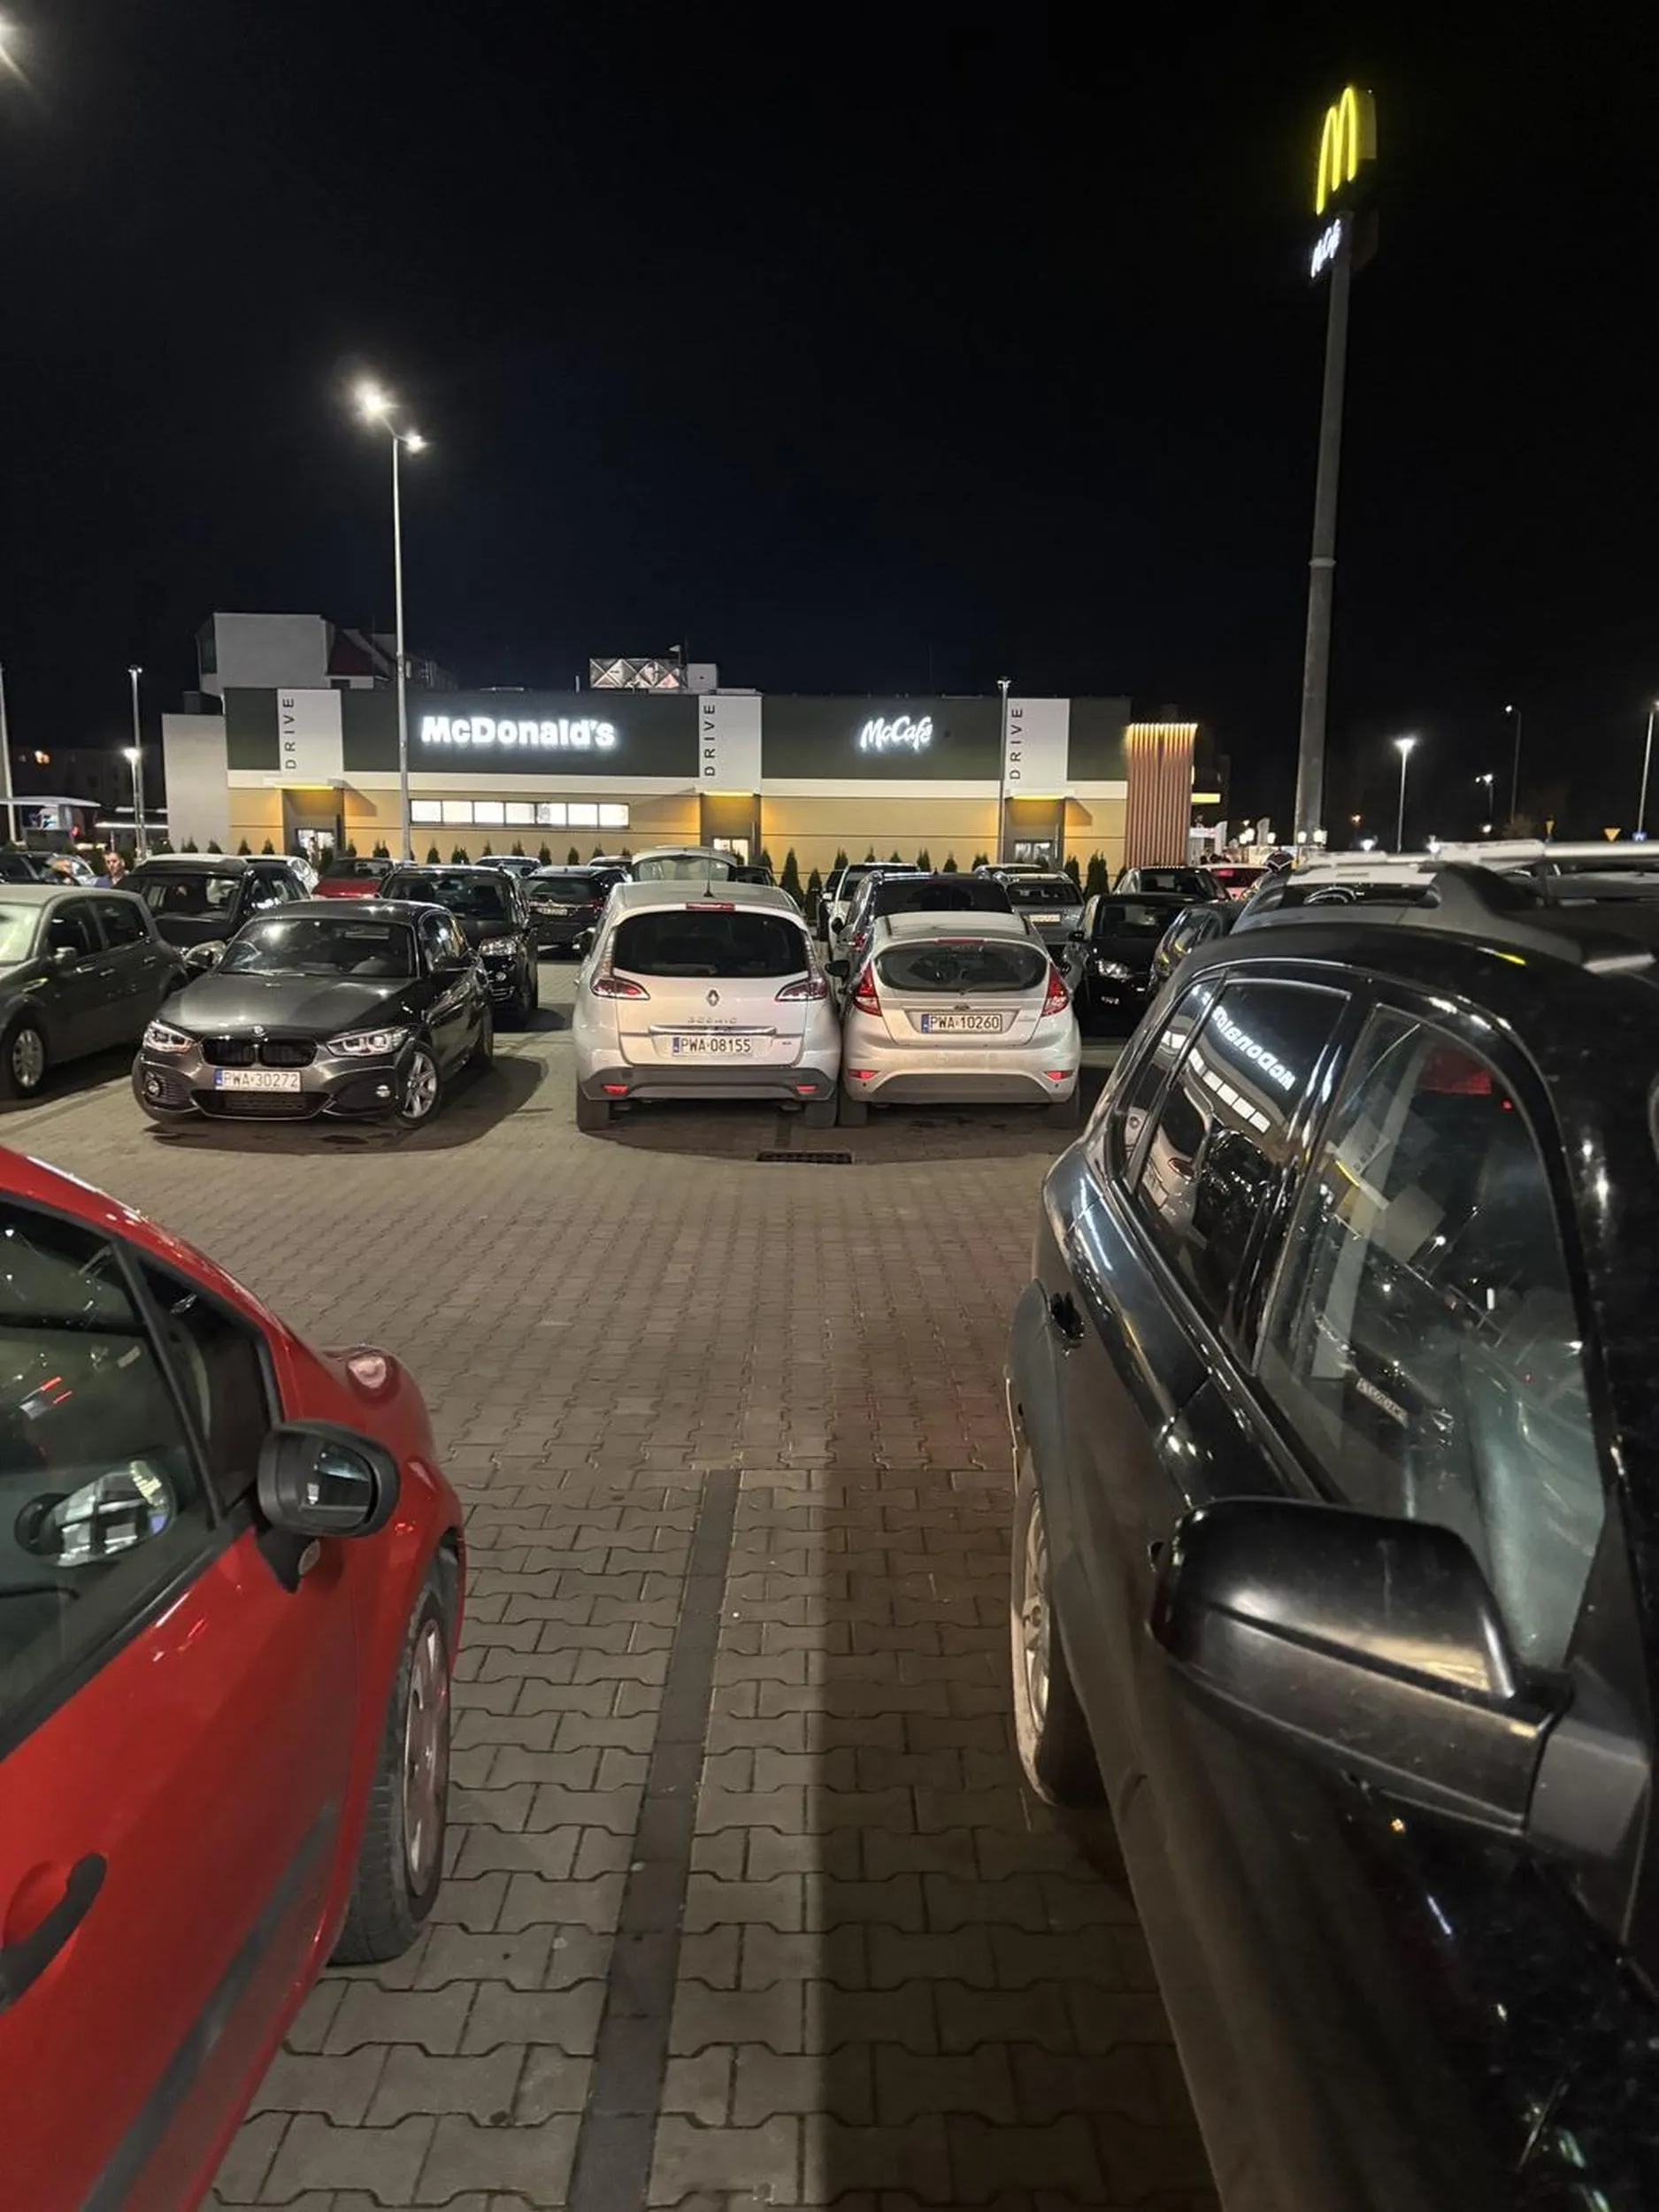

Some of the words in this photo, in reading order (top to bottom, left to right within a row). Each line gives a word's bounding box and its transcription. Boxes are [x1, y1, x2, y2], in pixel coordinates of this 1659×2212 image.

[282, 698, 297, 770] DRIVE
[420, 715, 617, 748] McDonald's
[703, 704, 716, 777] DRIVE
[1009, 709, 1023, 780] DRIVE
